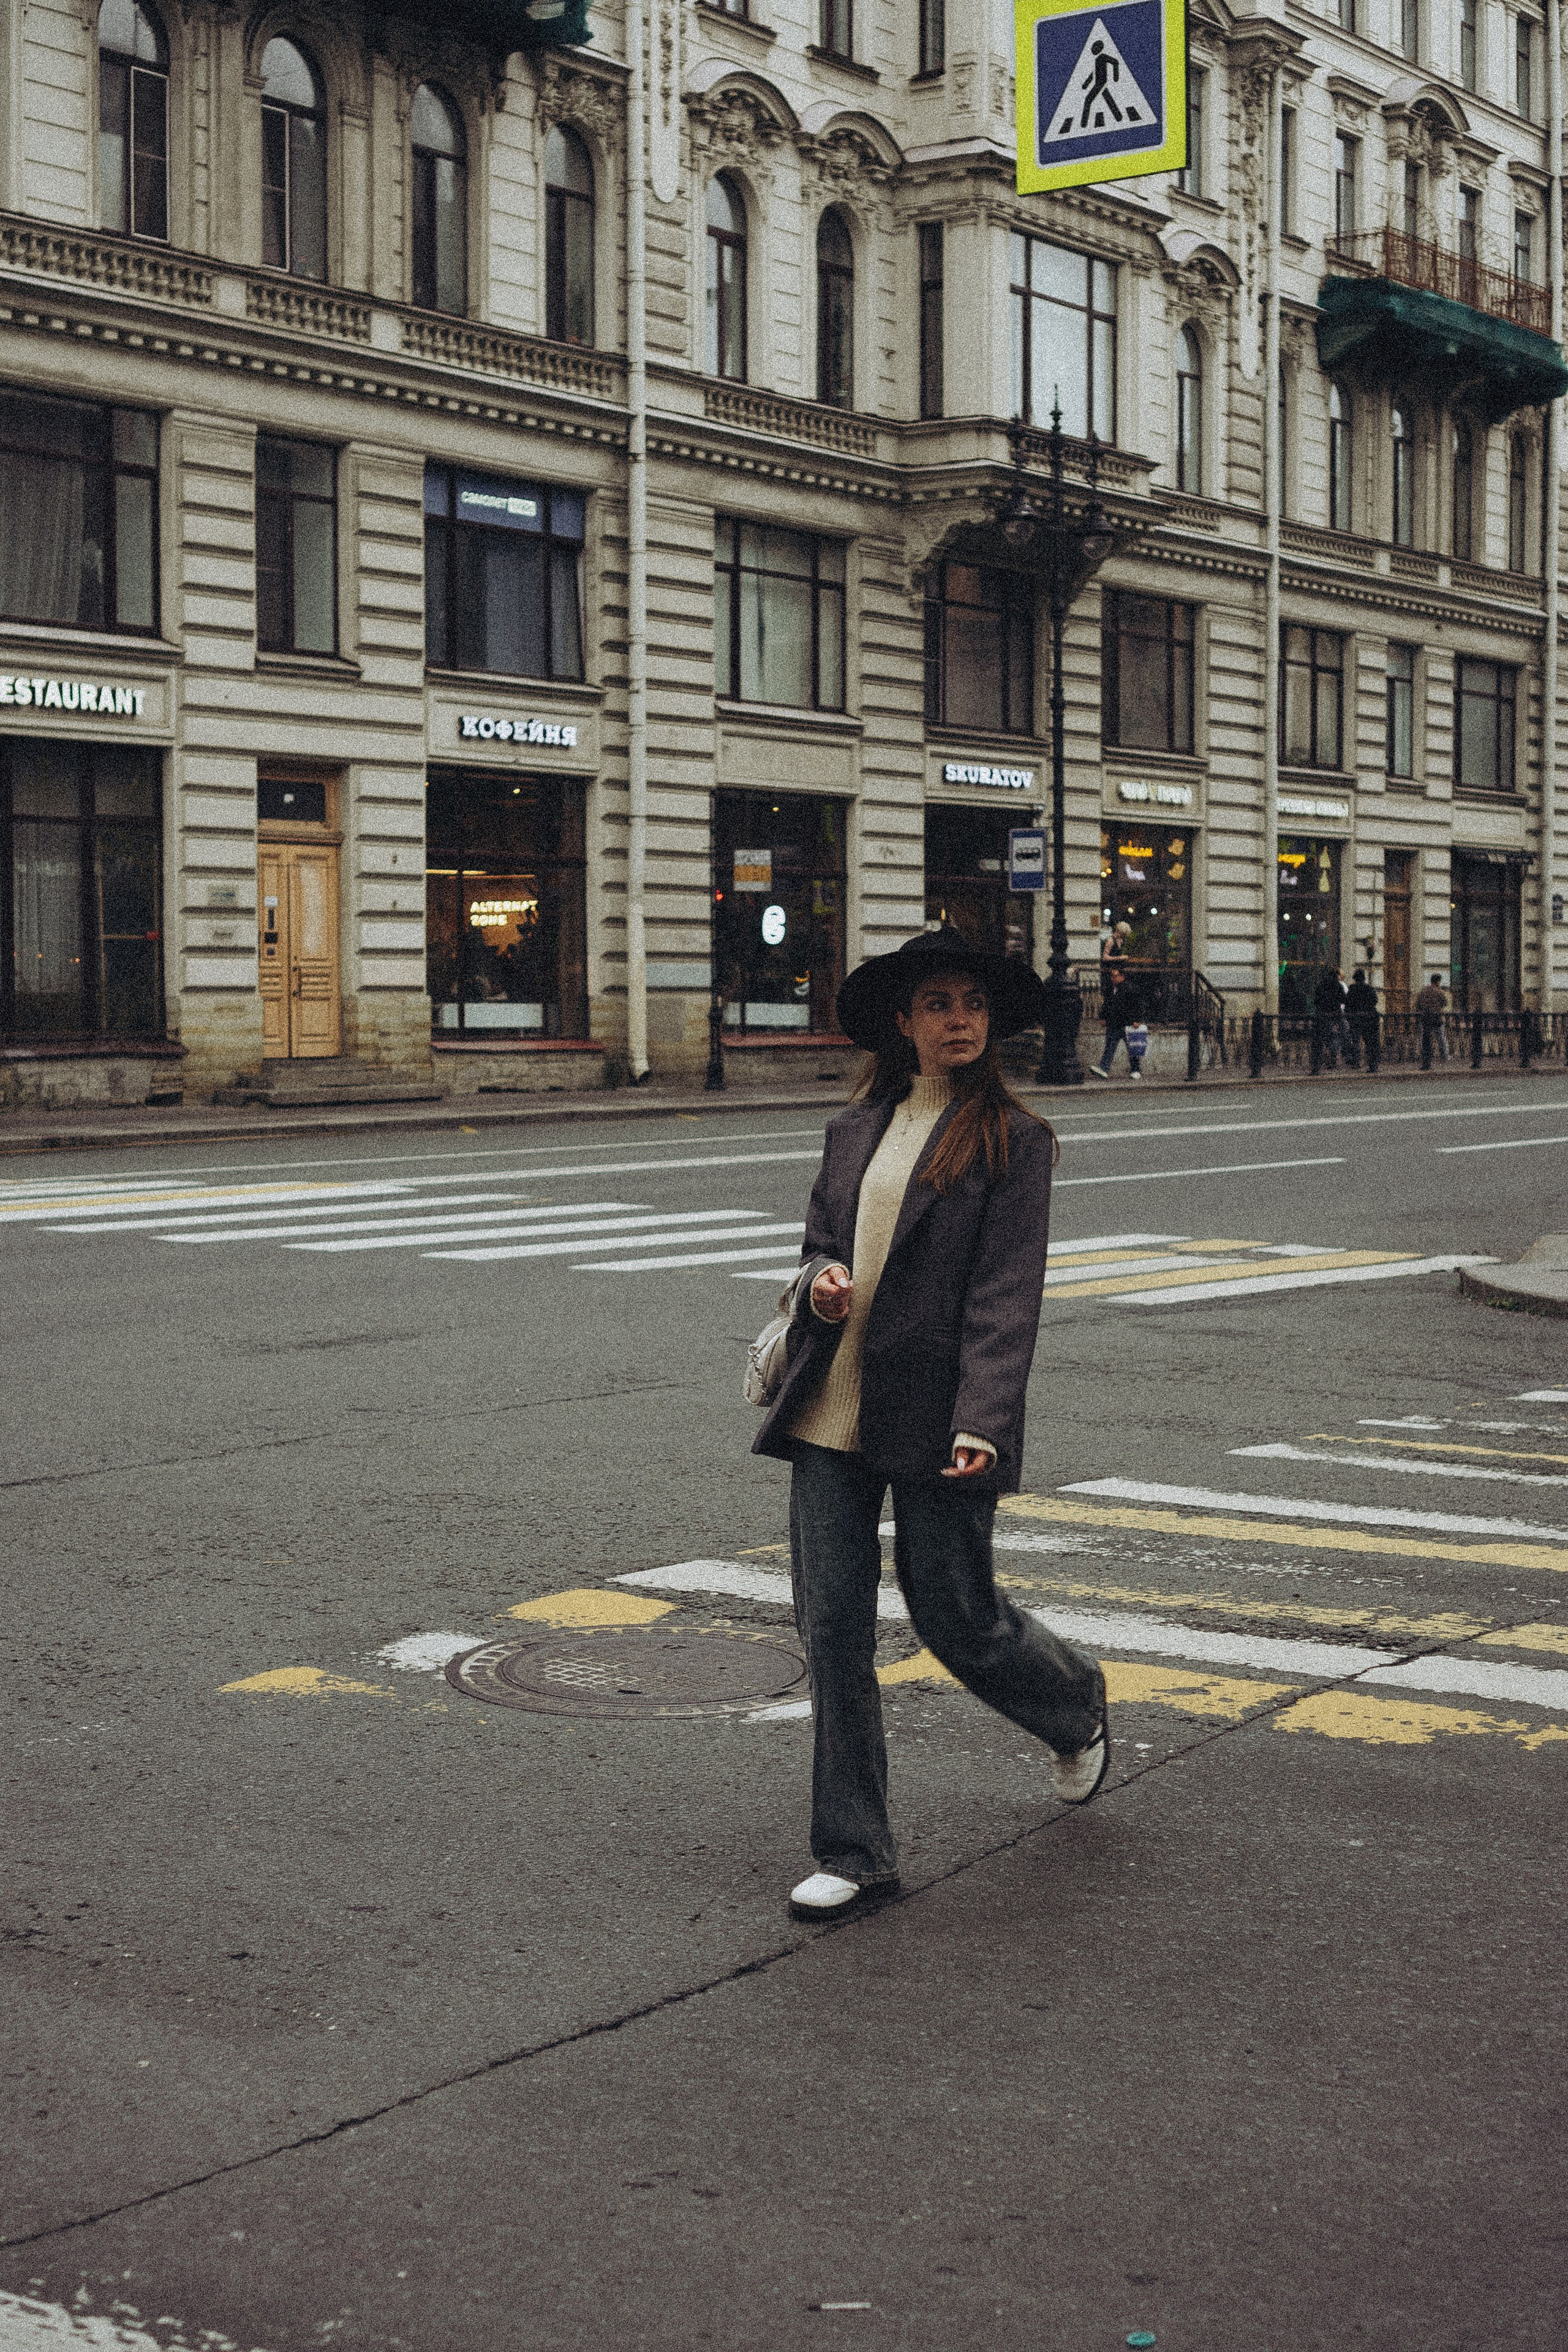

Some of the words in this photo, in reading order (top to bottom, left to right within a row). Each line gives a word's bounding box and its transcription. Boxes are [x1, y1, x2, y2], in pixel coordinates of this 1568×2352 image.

[462, 715, 578, 747] КОФЕЙНЯ
[945, 763, 1033, 788] SKURATOV
[470, 914, 508, 927] ZONE
